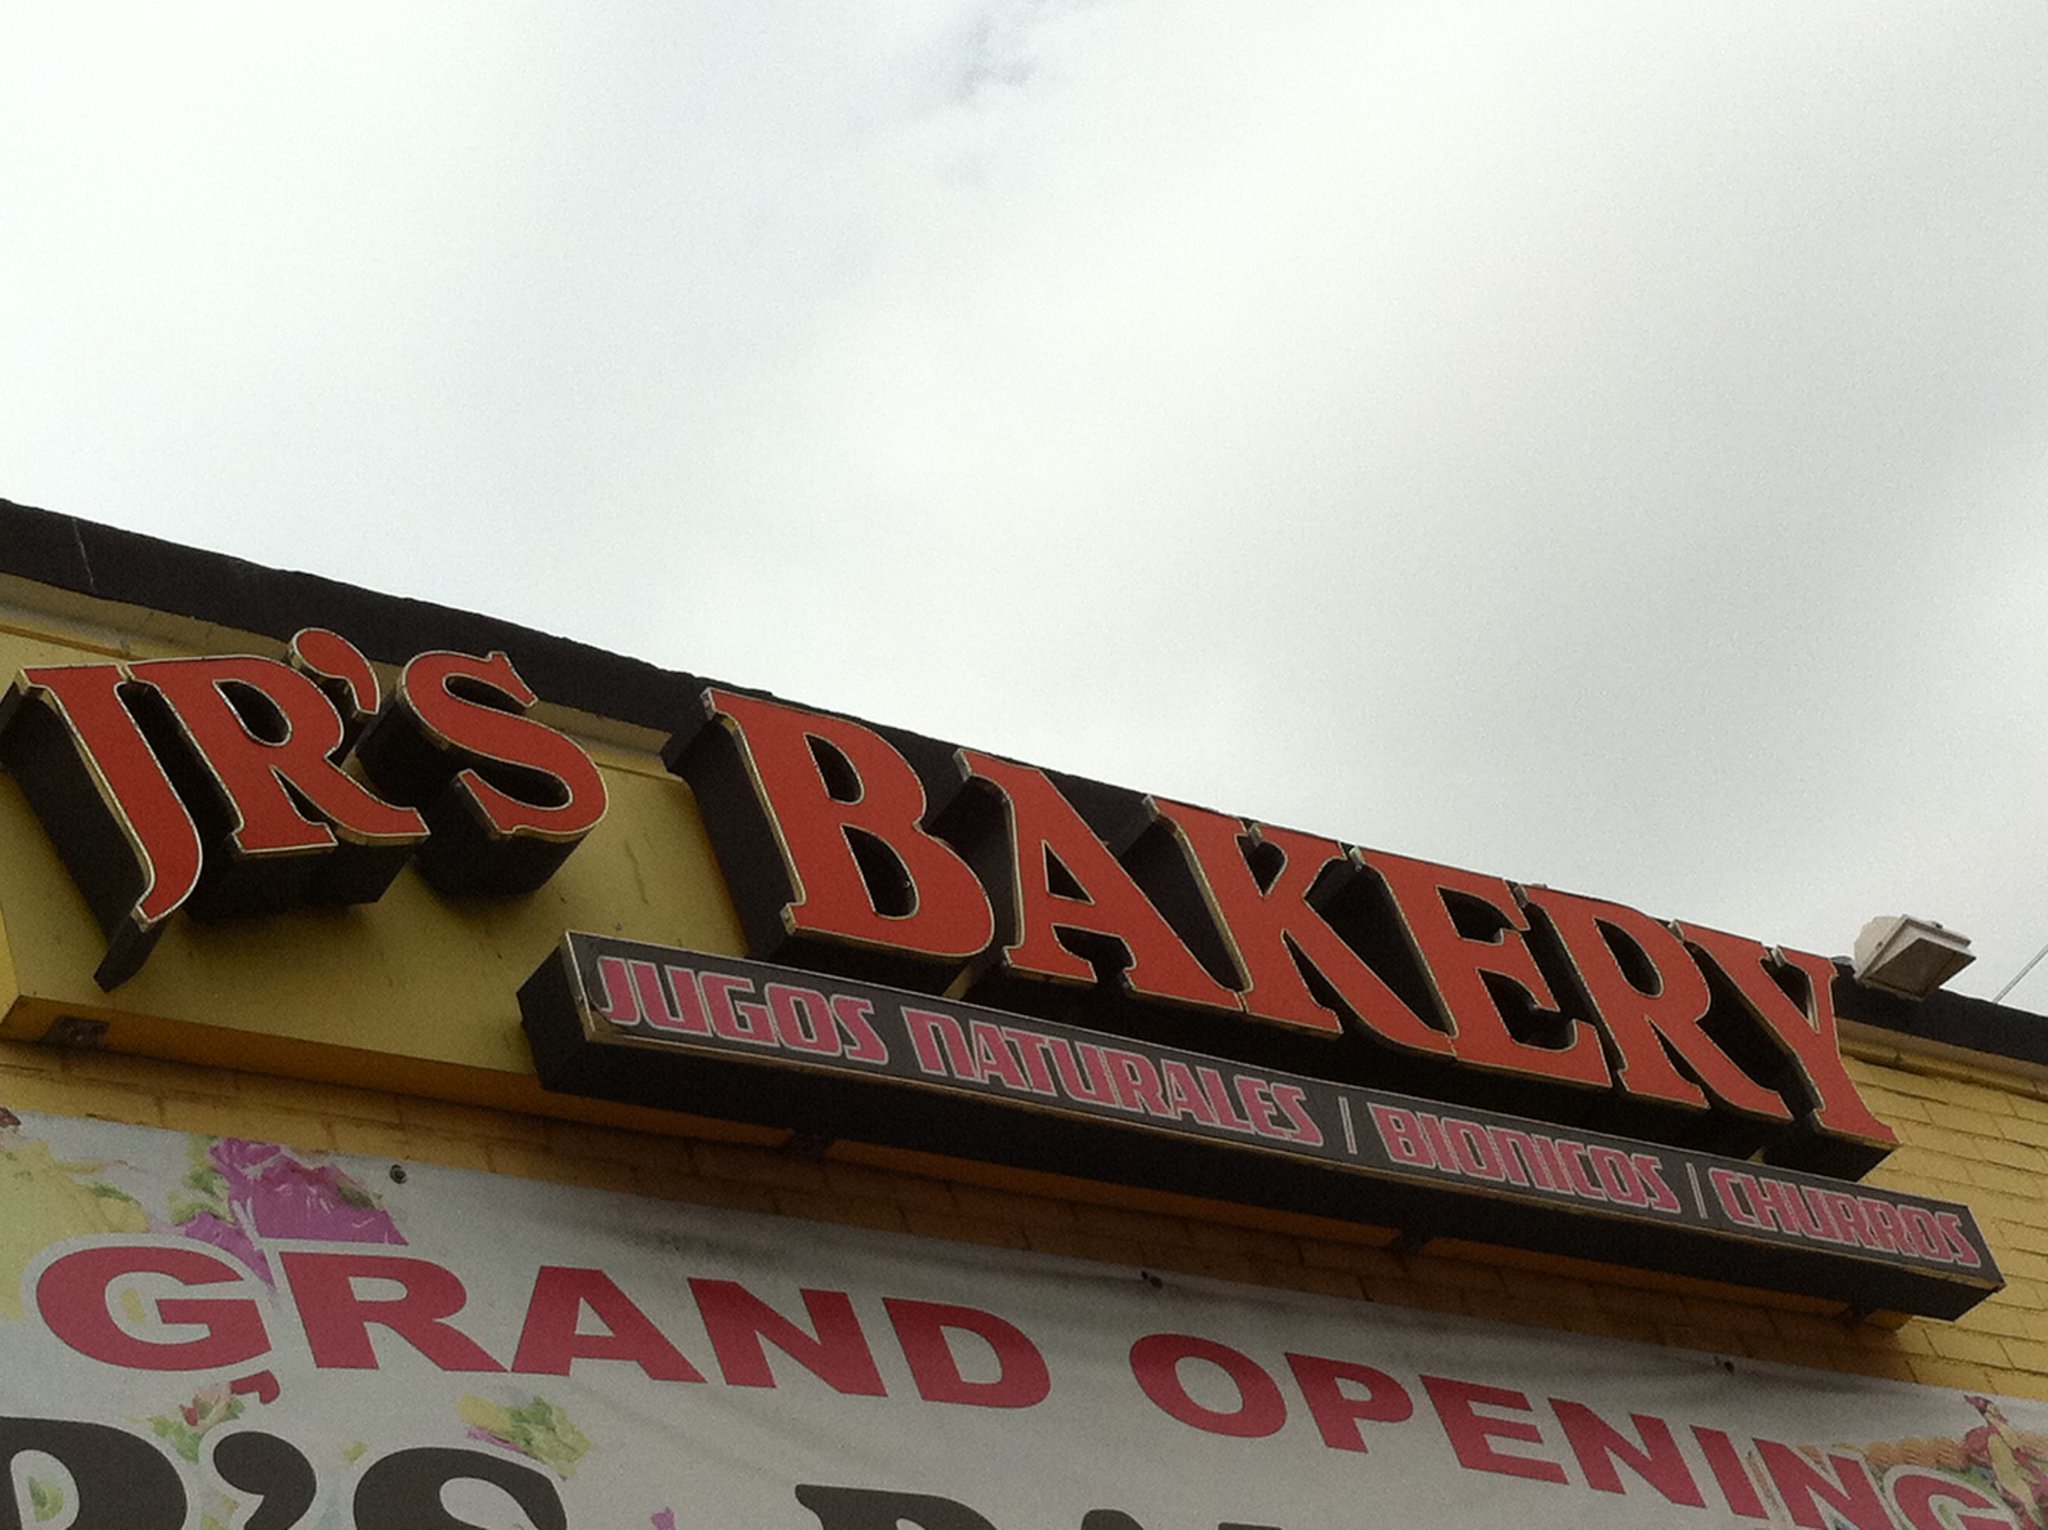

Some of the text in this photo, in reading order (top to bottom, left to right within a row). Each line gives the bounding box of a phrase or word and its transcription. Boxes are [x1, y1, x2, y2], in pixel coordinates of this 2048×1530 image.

[16, 628, 1899, 1144] JR'S BAKERY
[595, 954, 889, 1066] JUGOS
[900, 1006, 1326, 1149] NATURALES
[1366, 1102, 1683, 1215] BIONICOS
[1707, 1167, 1983, 1269] CHURROS
[36, 1245, 1052, 1410] GRAND
